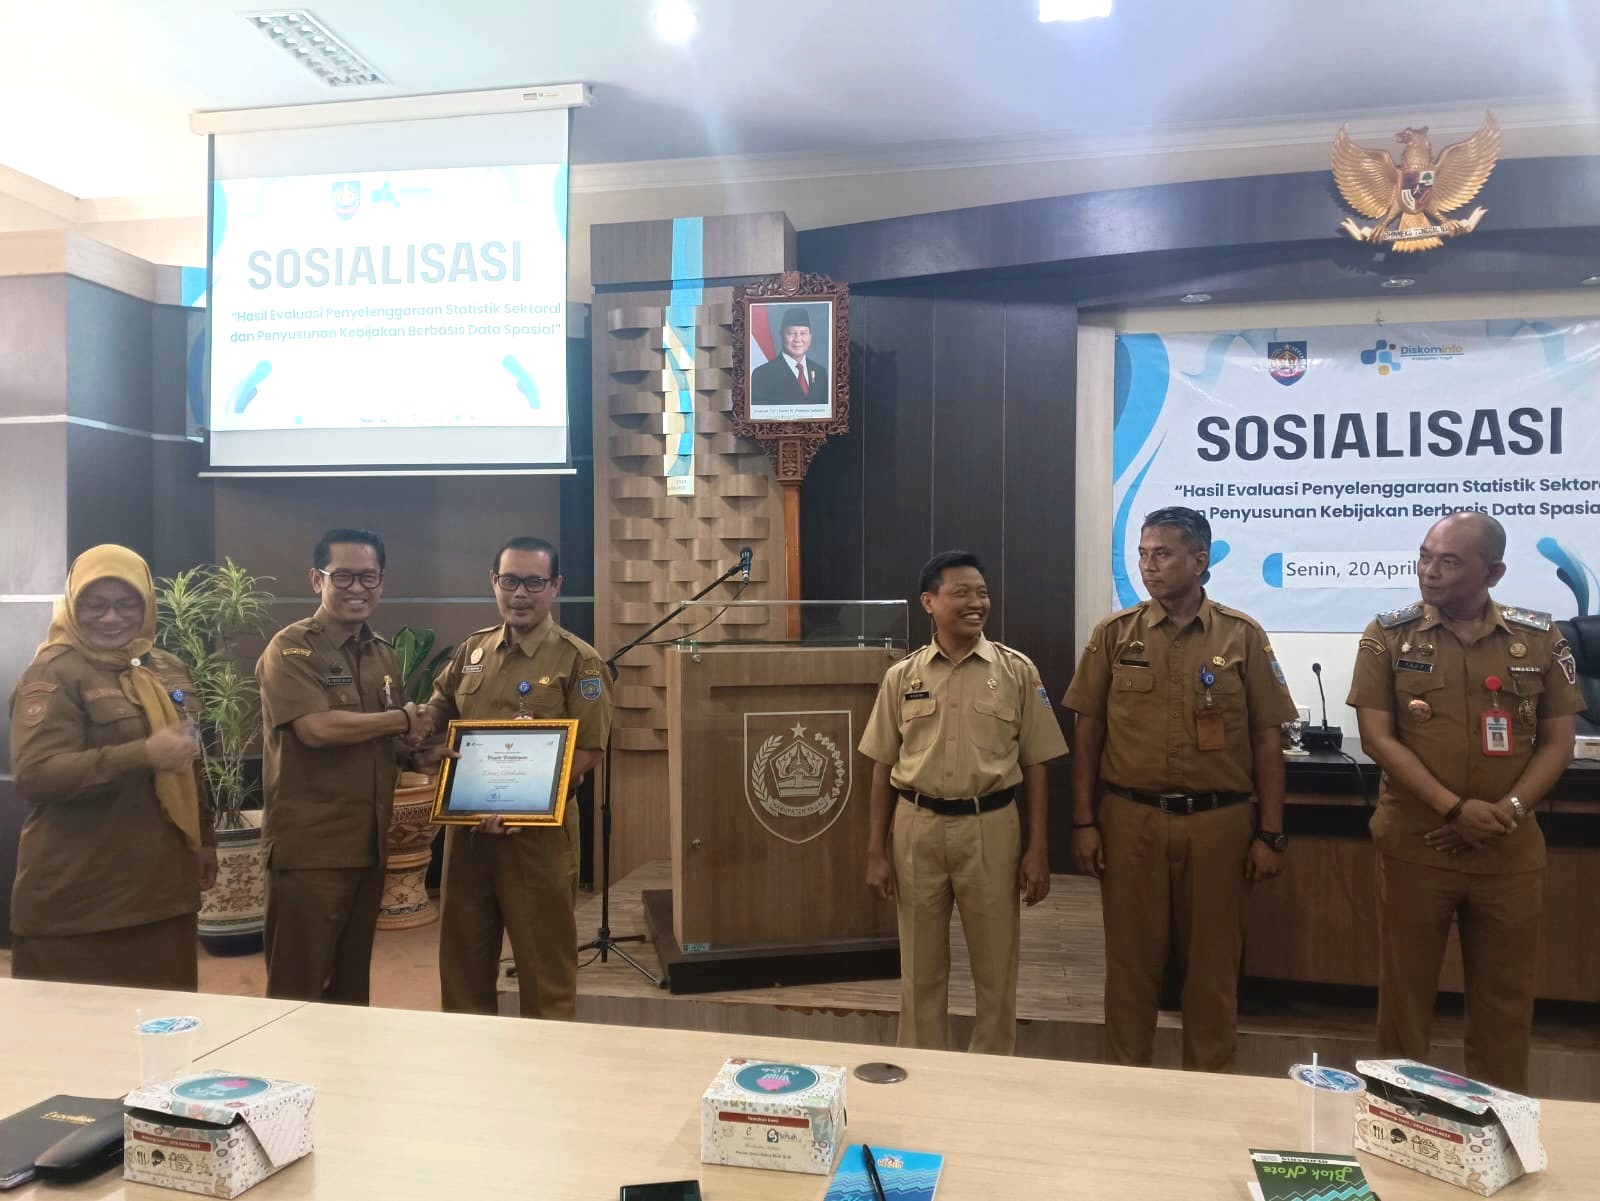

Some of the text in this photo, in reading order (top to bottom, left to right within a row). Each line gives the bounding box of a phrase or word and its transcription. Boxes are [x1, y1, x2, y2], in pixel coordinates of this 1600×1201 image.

[248, 240, 522, 290] SOSIALISASI
[270, 307, 323, 321] Evaluasi
[326, 305, 442, 321] Penyelenggaraan
[446, 303, 500, 315] Statistik
[504, 302, 561, 314] Sektoral
[230, 331, 255, 342] dan
[257, 328, 337, 343] Penyusunan
[339, 326, 405, 340] Kebijakan
[408, 324, 465, 336] Berbasis
[468, 324, 501, 335] Data
[1400, 344, 1463, 354] Diskominfo
[1196, 406, 1563, 462] SOSIALISASI
[1174, 477, 1600, 499] “Hasil Evaluasi Penyelenggaraan Statistik Sektor
[1209, 505, 1317, 523] Penyusunan
[1320, 503, 1409, 521] Kebijakan
[1492, 502, 1536, 516] Data
[1286, 560, 1417, 580] Senin, 20 April
[1263, 1165, 1353, 1182] Blok Note
